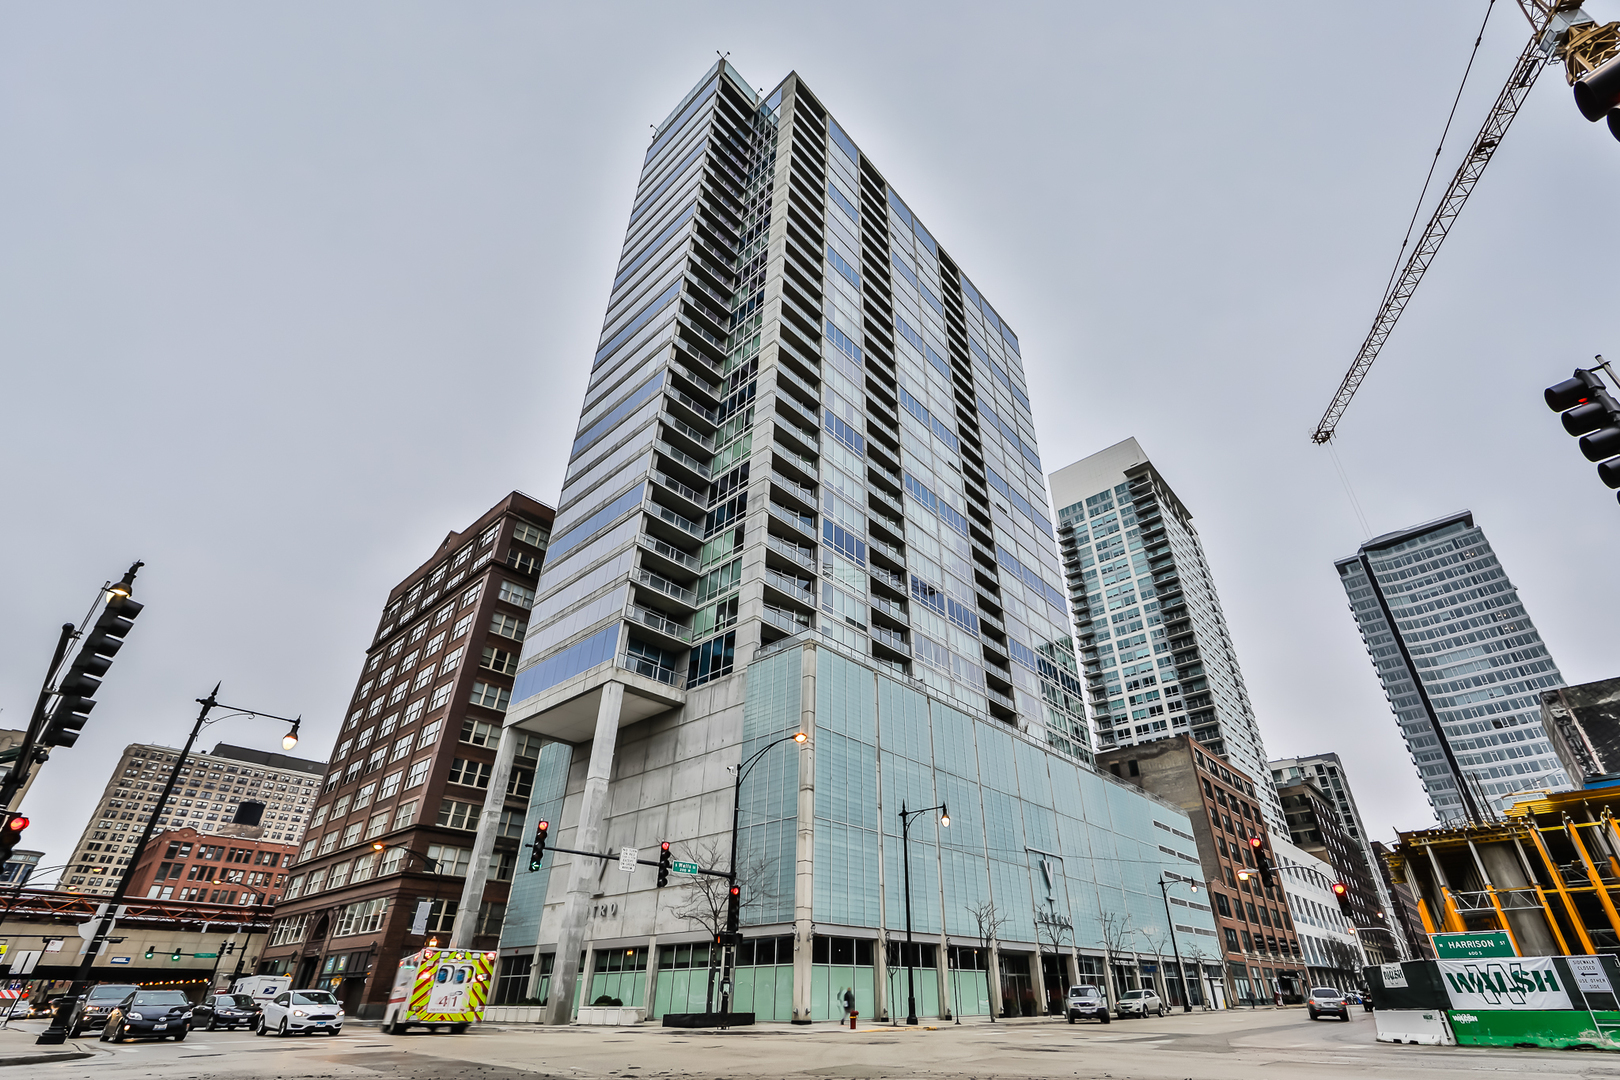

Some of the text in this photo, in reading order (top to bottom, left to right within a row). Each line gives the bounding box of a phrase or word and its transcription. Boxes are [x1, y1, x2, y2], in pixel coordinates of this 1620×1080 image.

[1447, 939, 1495, 949] HARRISON
[1445, 969, 1561, 995] WALSH
[438, 995, 458, 1007] 41
